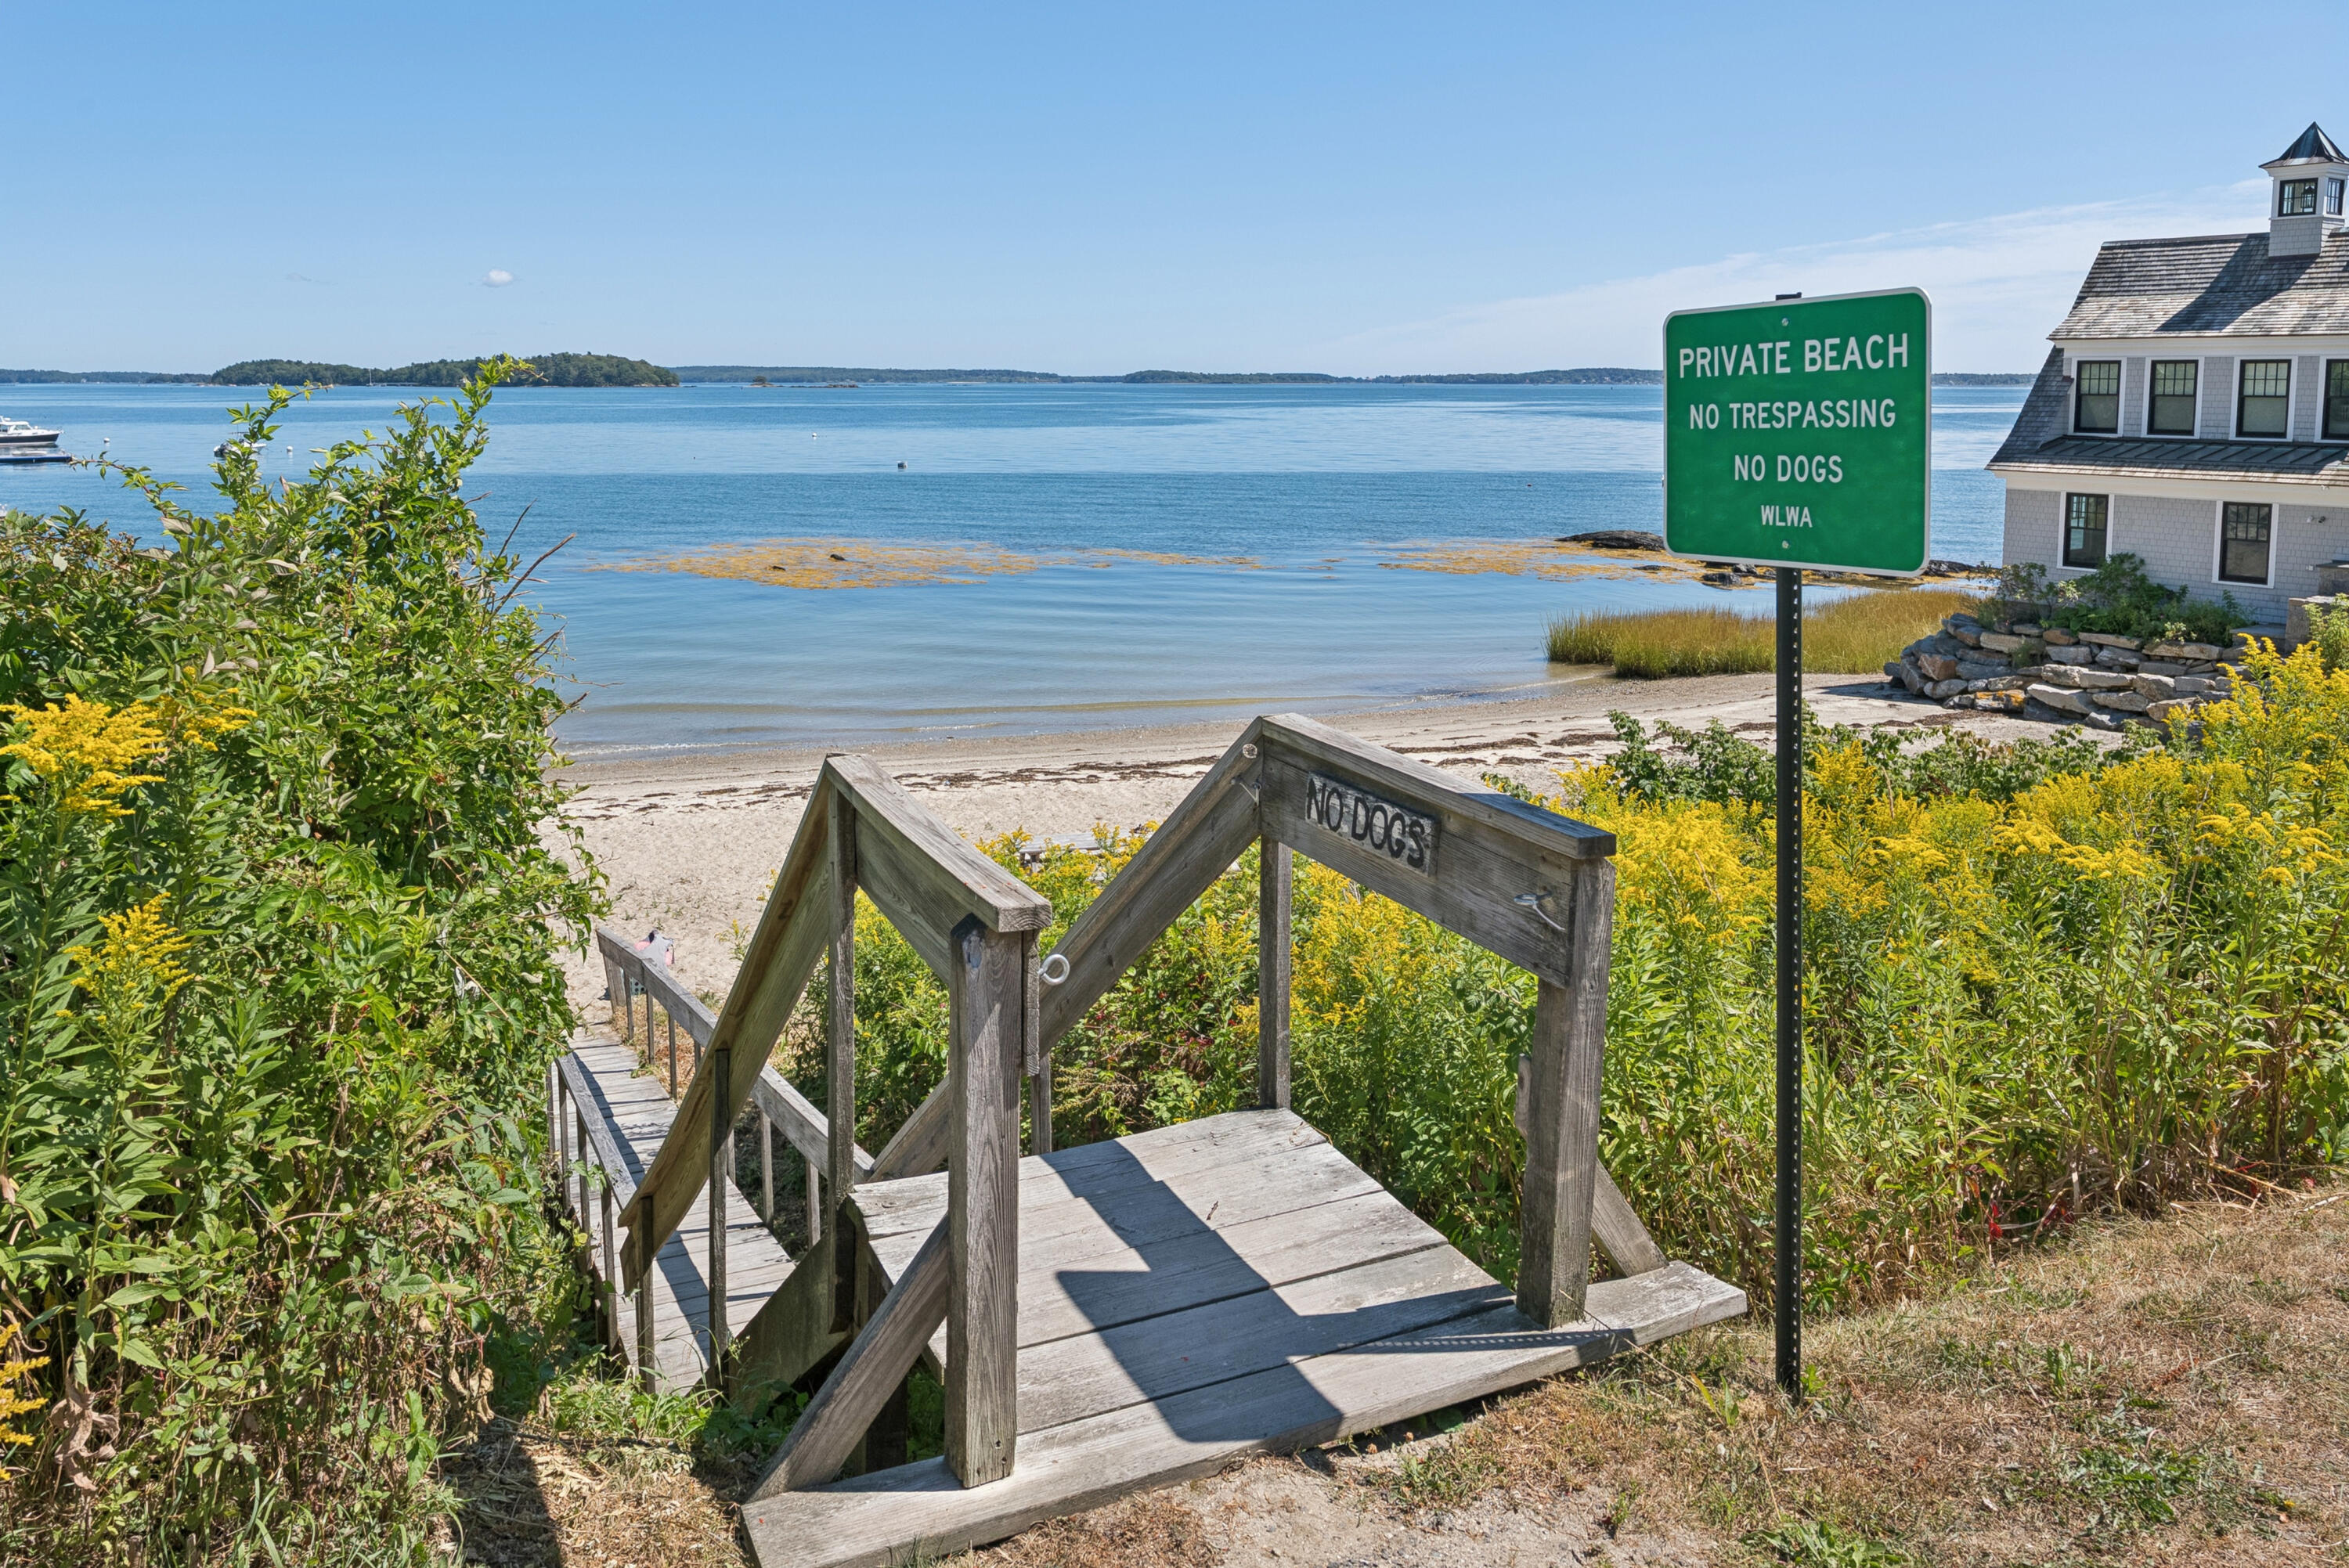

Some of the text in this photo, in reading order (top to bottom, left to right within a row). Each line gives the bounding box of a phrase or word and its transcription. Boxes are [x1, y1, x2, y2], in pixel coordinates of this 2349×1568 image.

[1680, 333, 1908, 378] PRIVATE BEACH
[1690, 398, 1896, 429] NO TRESPASSING
[1734, 455, 1843, 483] NO DOGS
[1761, 505, 1813, 528] WLWA
[1307, 778, 1425, 868] NO DOGS
